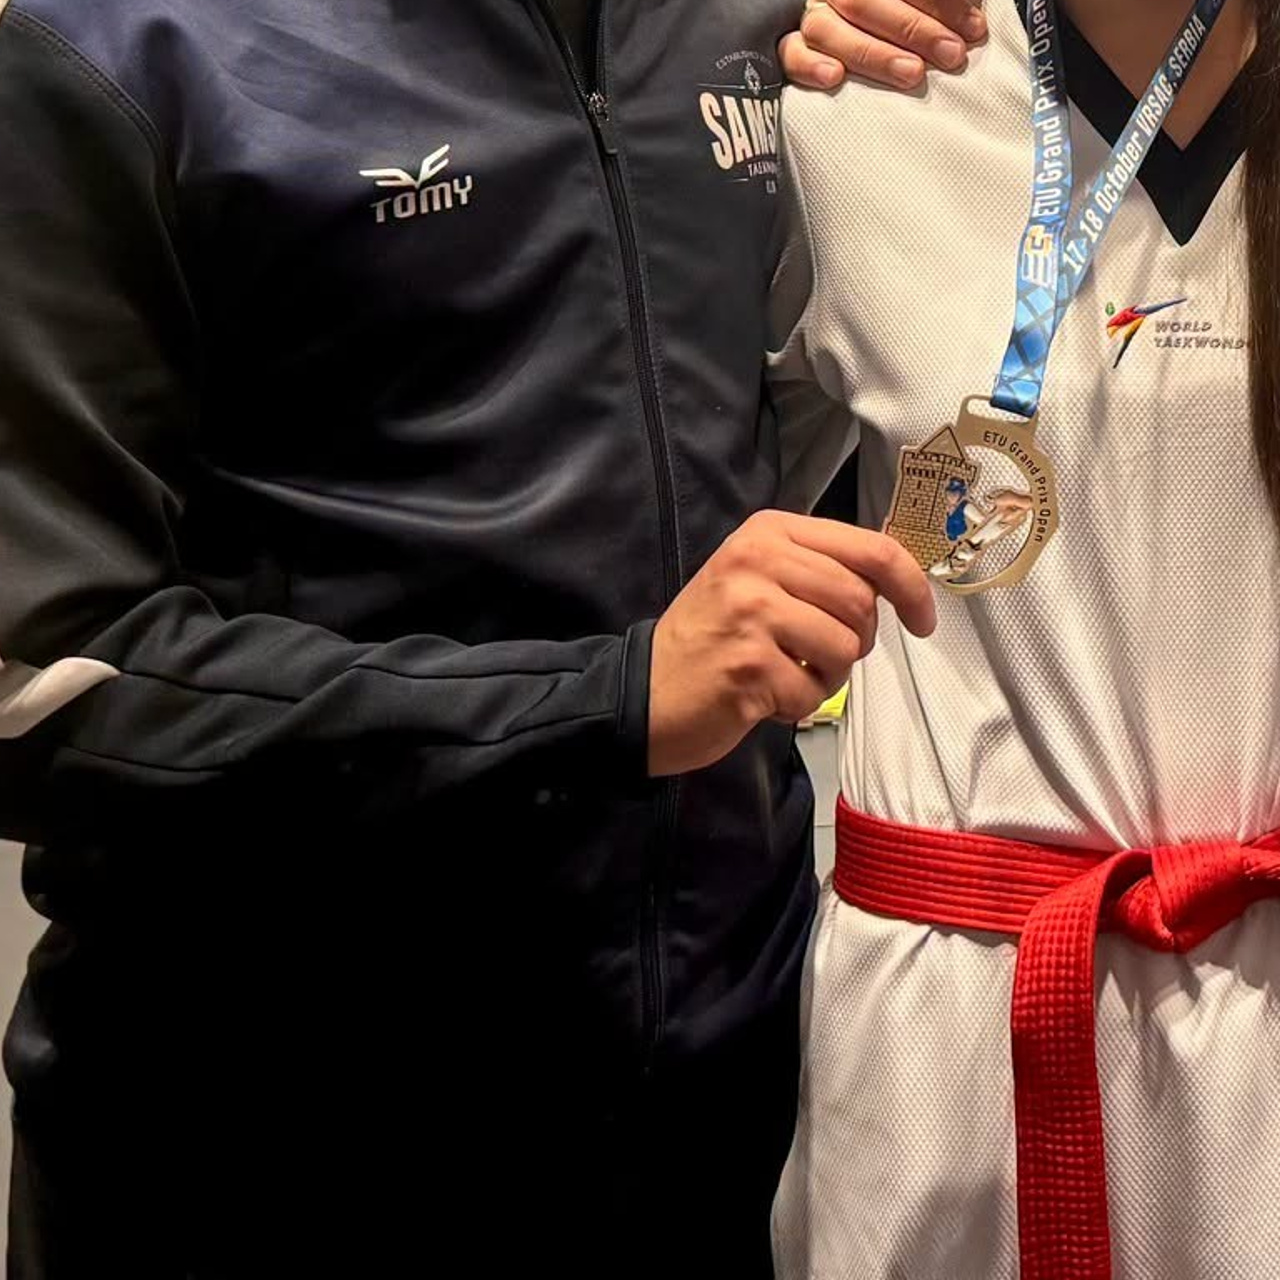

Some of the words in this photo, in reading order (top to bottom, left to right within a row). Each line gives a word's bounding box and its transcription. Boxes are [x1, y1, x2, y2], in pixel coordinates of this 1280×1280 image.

[1033, 59, 1058, 113] Prix
[1094, 129, 1145, 215] October
[1167, 13, 1207, 79] SERBIA
[1035, 109, 1063, 186] Grand
[369, 174, 473, 223] TOMY
[1031, 182, 1063, 220] ETU
[1154, 320, 1213, 333] WORLD
[983, 430, 1008, 448] ETU
[1009, 441, 1041, 476] Grand
[1034, 508, 1051, 543] Open
